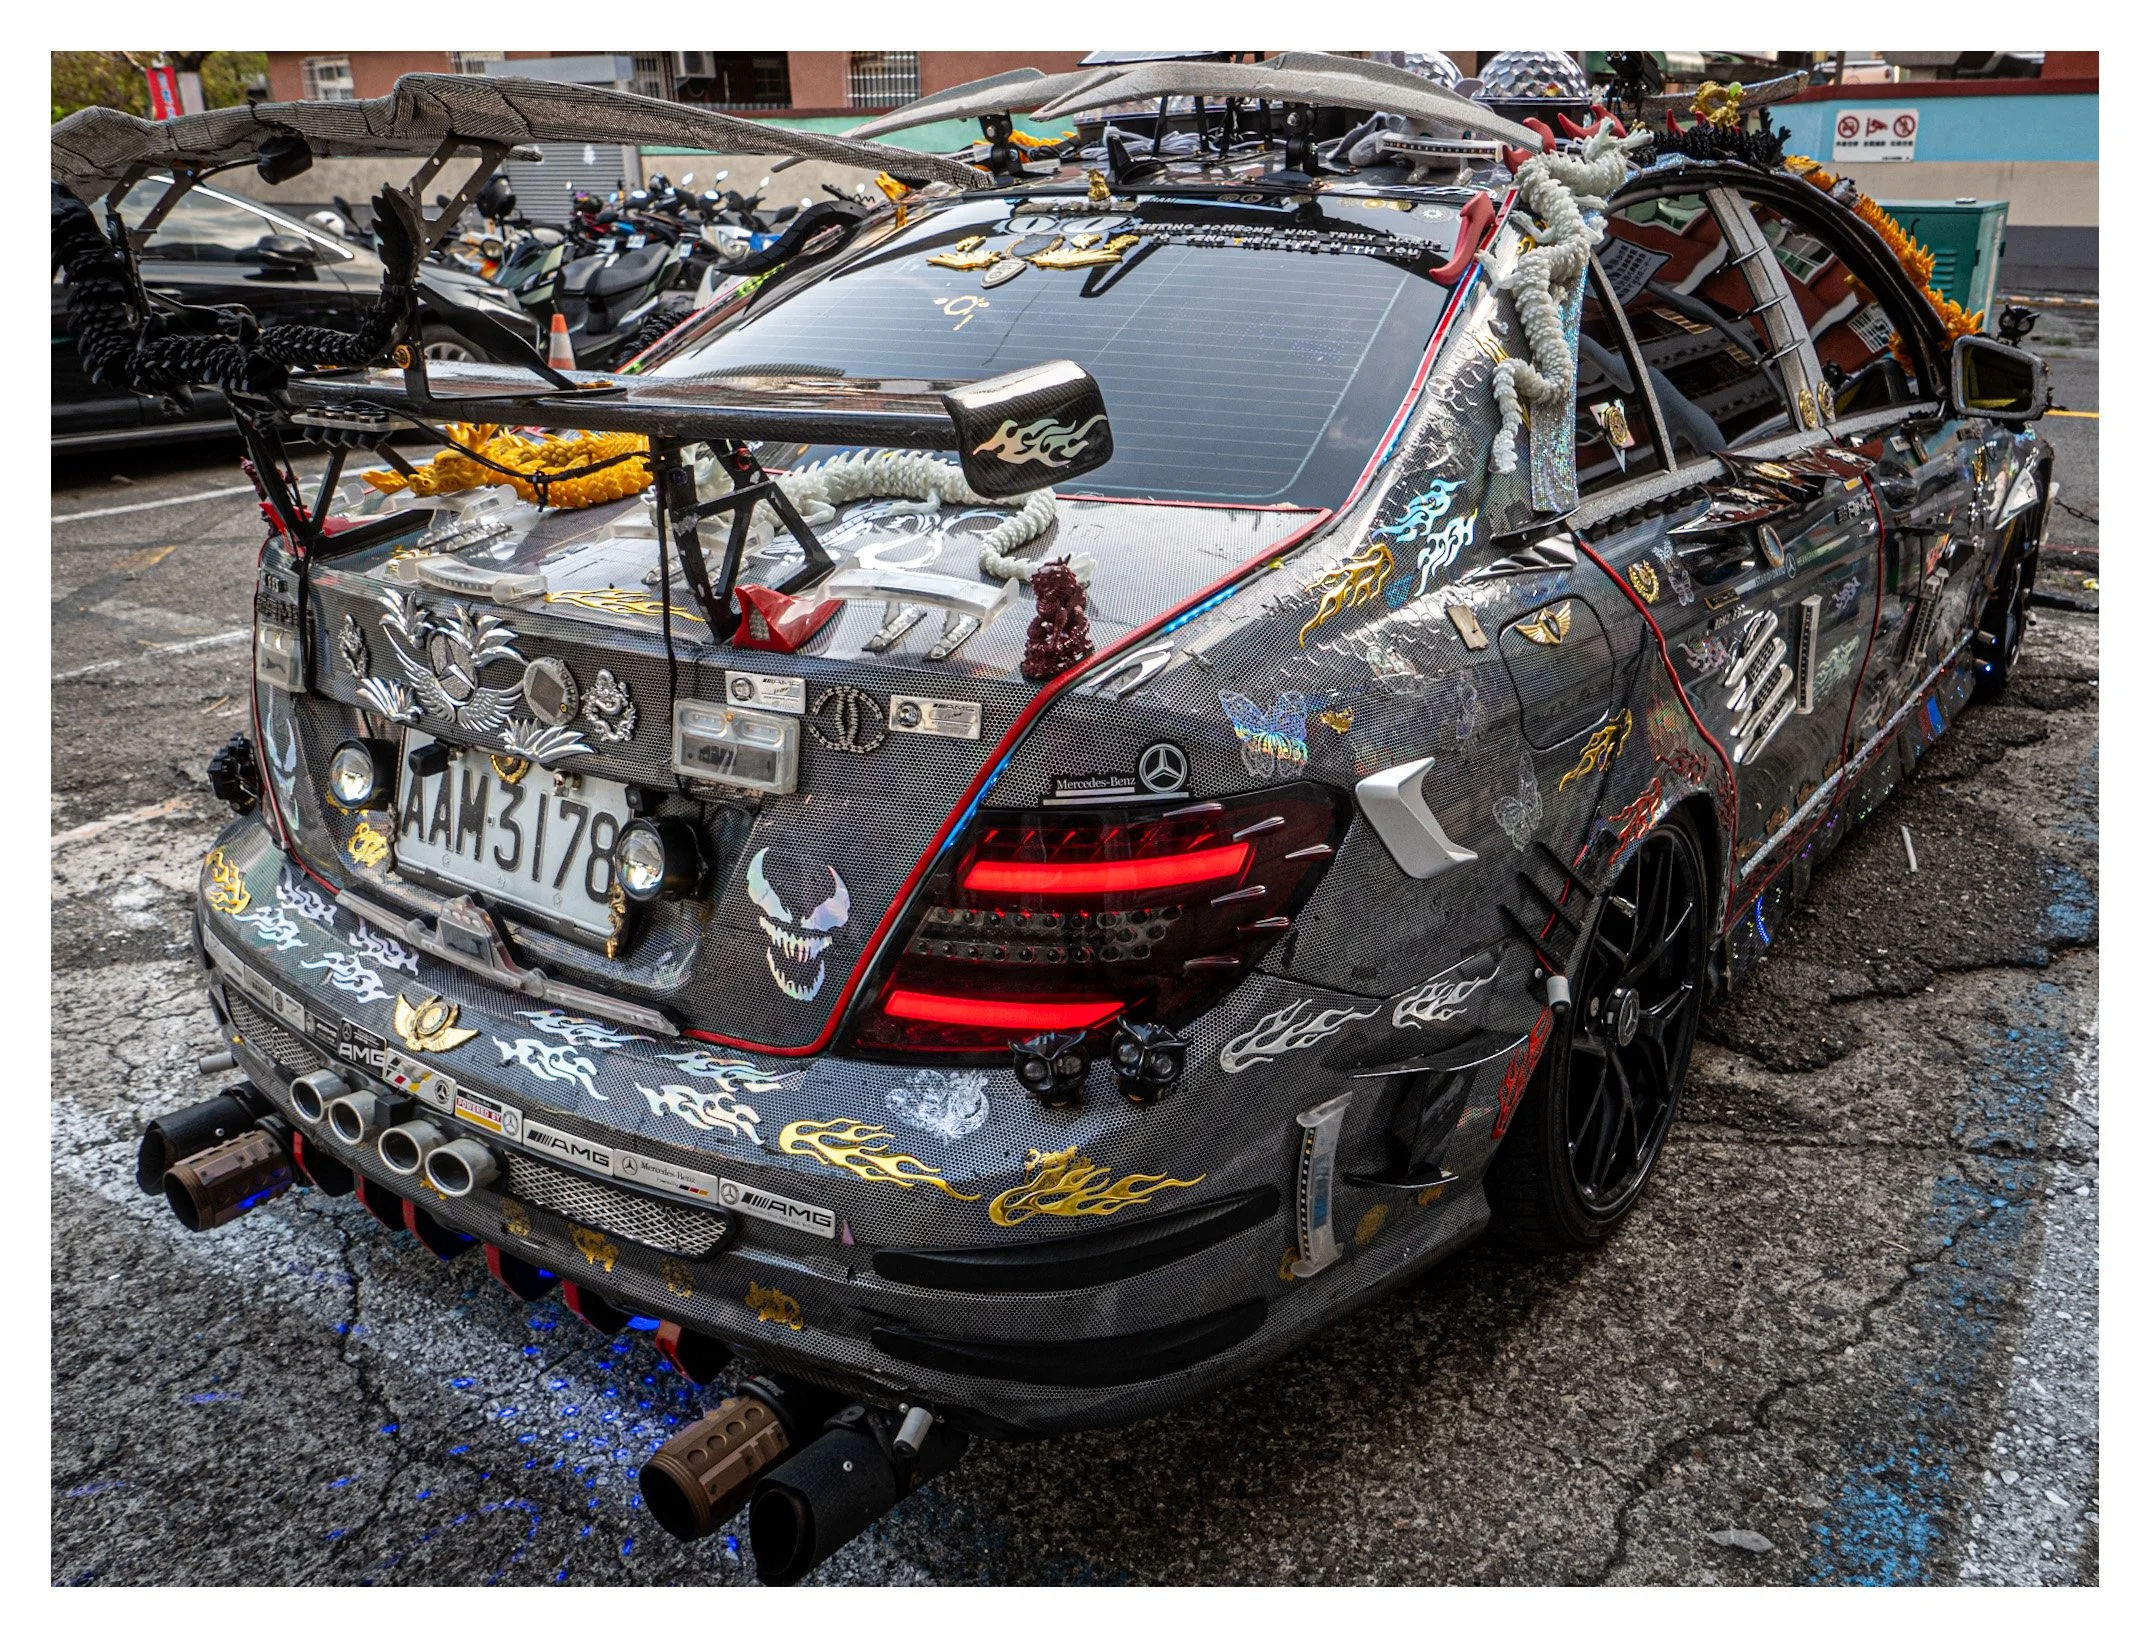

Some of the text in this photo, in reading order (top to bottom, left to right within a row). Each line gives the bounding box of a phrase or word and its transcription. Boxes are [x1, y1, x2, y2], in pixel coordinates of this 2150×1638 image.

[1200, 224, 1275, 235] SOMEONE
[1284, 228, 1318, 237] WHO
[1328, 231, 1376, 242] TRULY
[1232, 236, 1279, 246] THEIR
[1285, 239, 1320, 250] LIFE
[1330, 241, 1377, 255] WITH
[1384, 245, 1420, 257] YOU
[1056, 775, 1137, 791] Mercedes-Benz
[401, 766, 620, 904] AAM-3178
[338, 1042, 385, 1068] AMG
[457, 1098, 489, 1117] POWERED
[491, 1112, 502, 1123] BY
[551, 1138, 610, 1167] AMG
[640, 1160, 697, 1184] Mercedes-Benz
[768, 1201, 833, 1228] AMG
